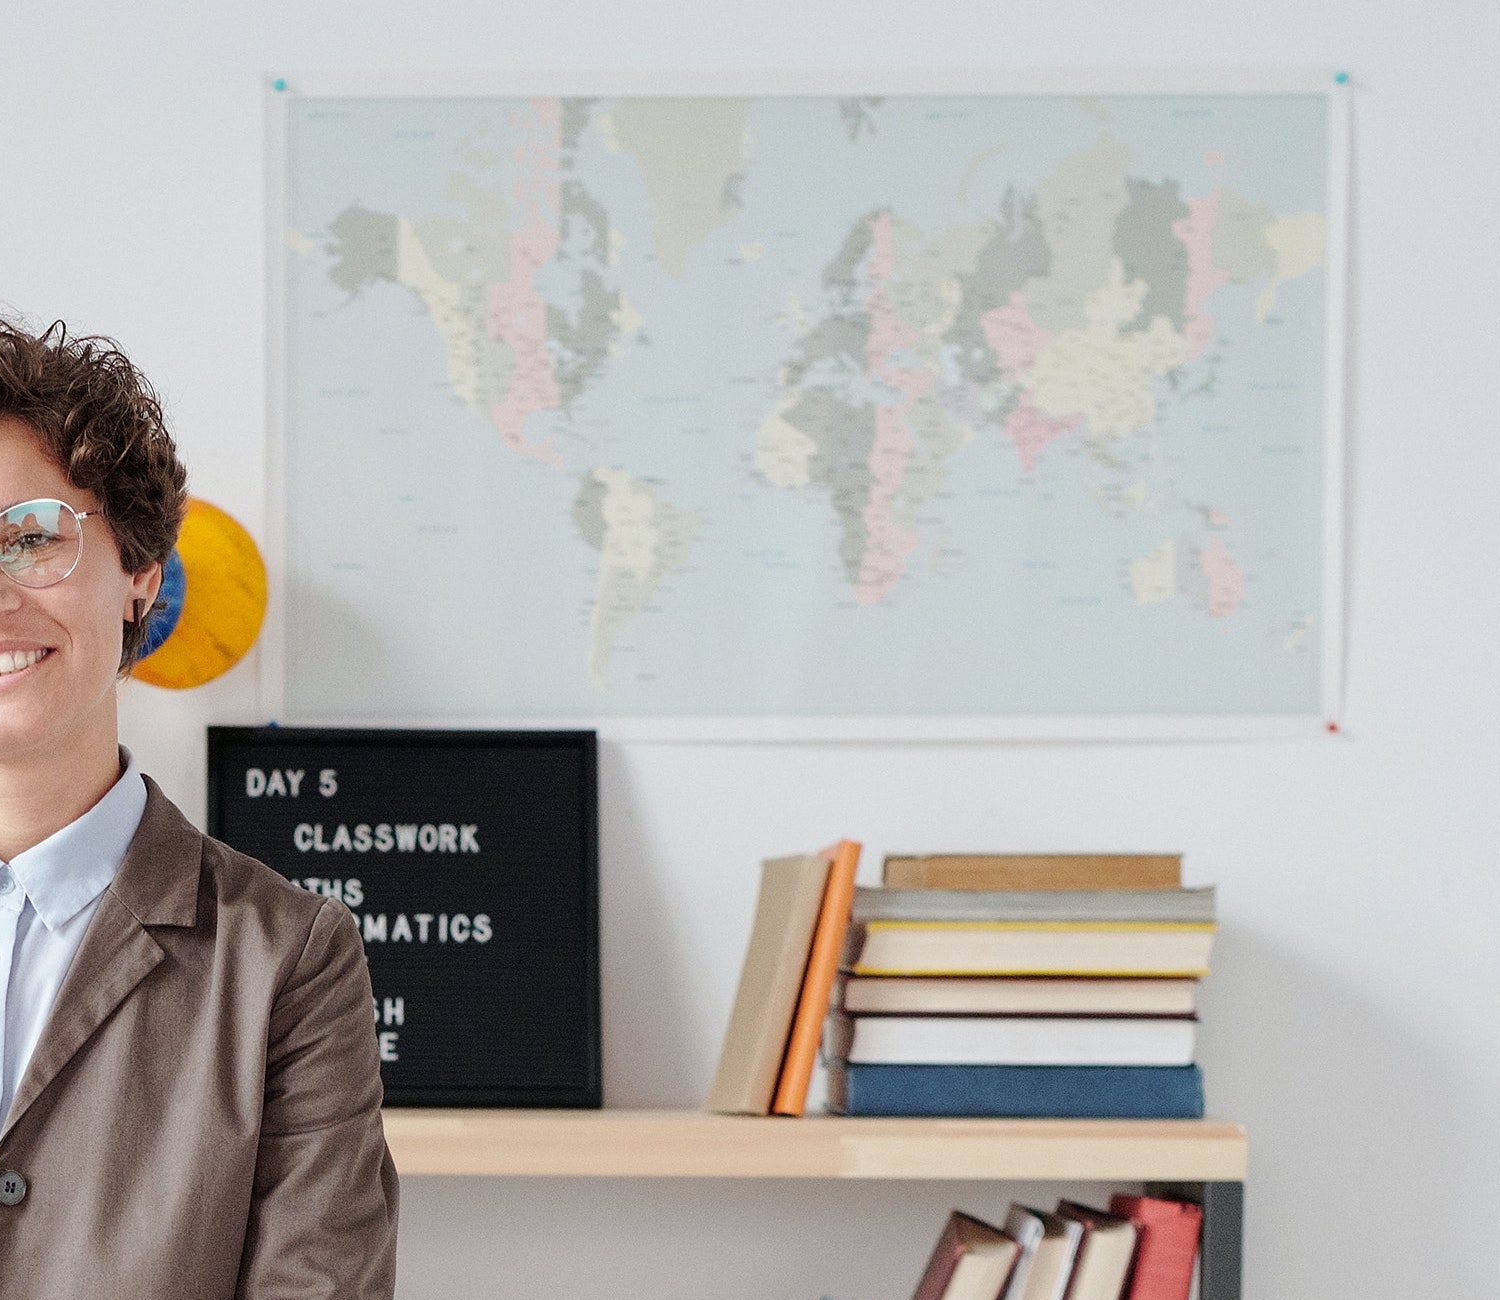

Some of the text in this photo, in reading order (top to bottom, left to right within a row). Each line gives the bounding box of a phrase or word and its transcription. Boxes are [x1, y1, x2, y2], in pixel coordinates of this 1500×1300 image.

[245, 768, 338, 798] DAY 5
[293, 823, 480, 853] CLASSWORK
[290, 877, 365, 908] THS
[353, 912, 494, 944] MATICS
